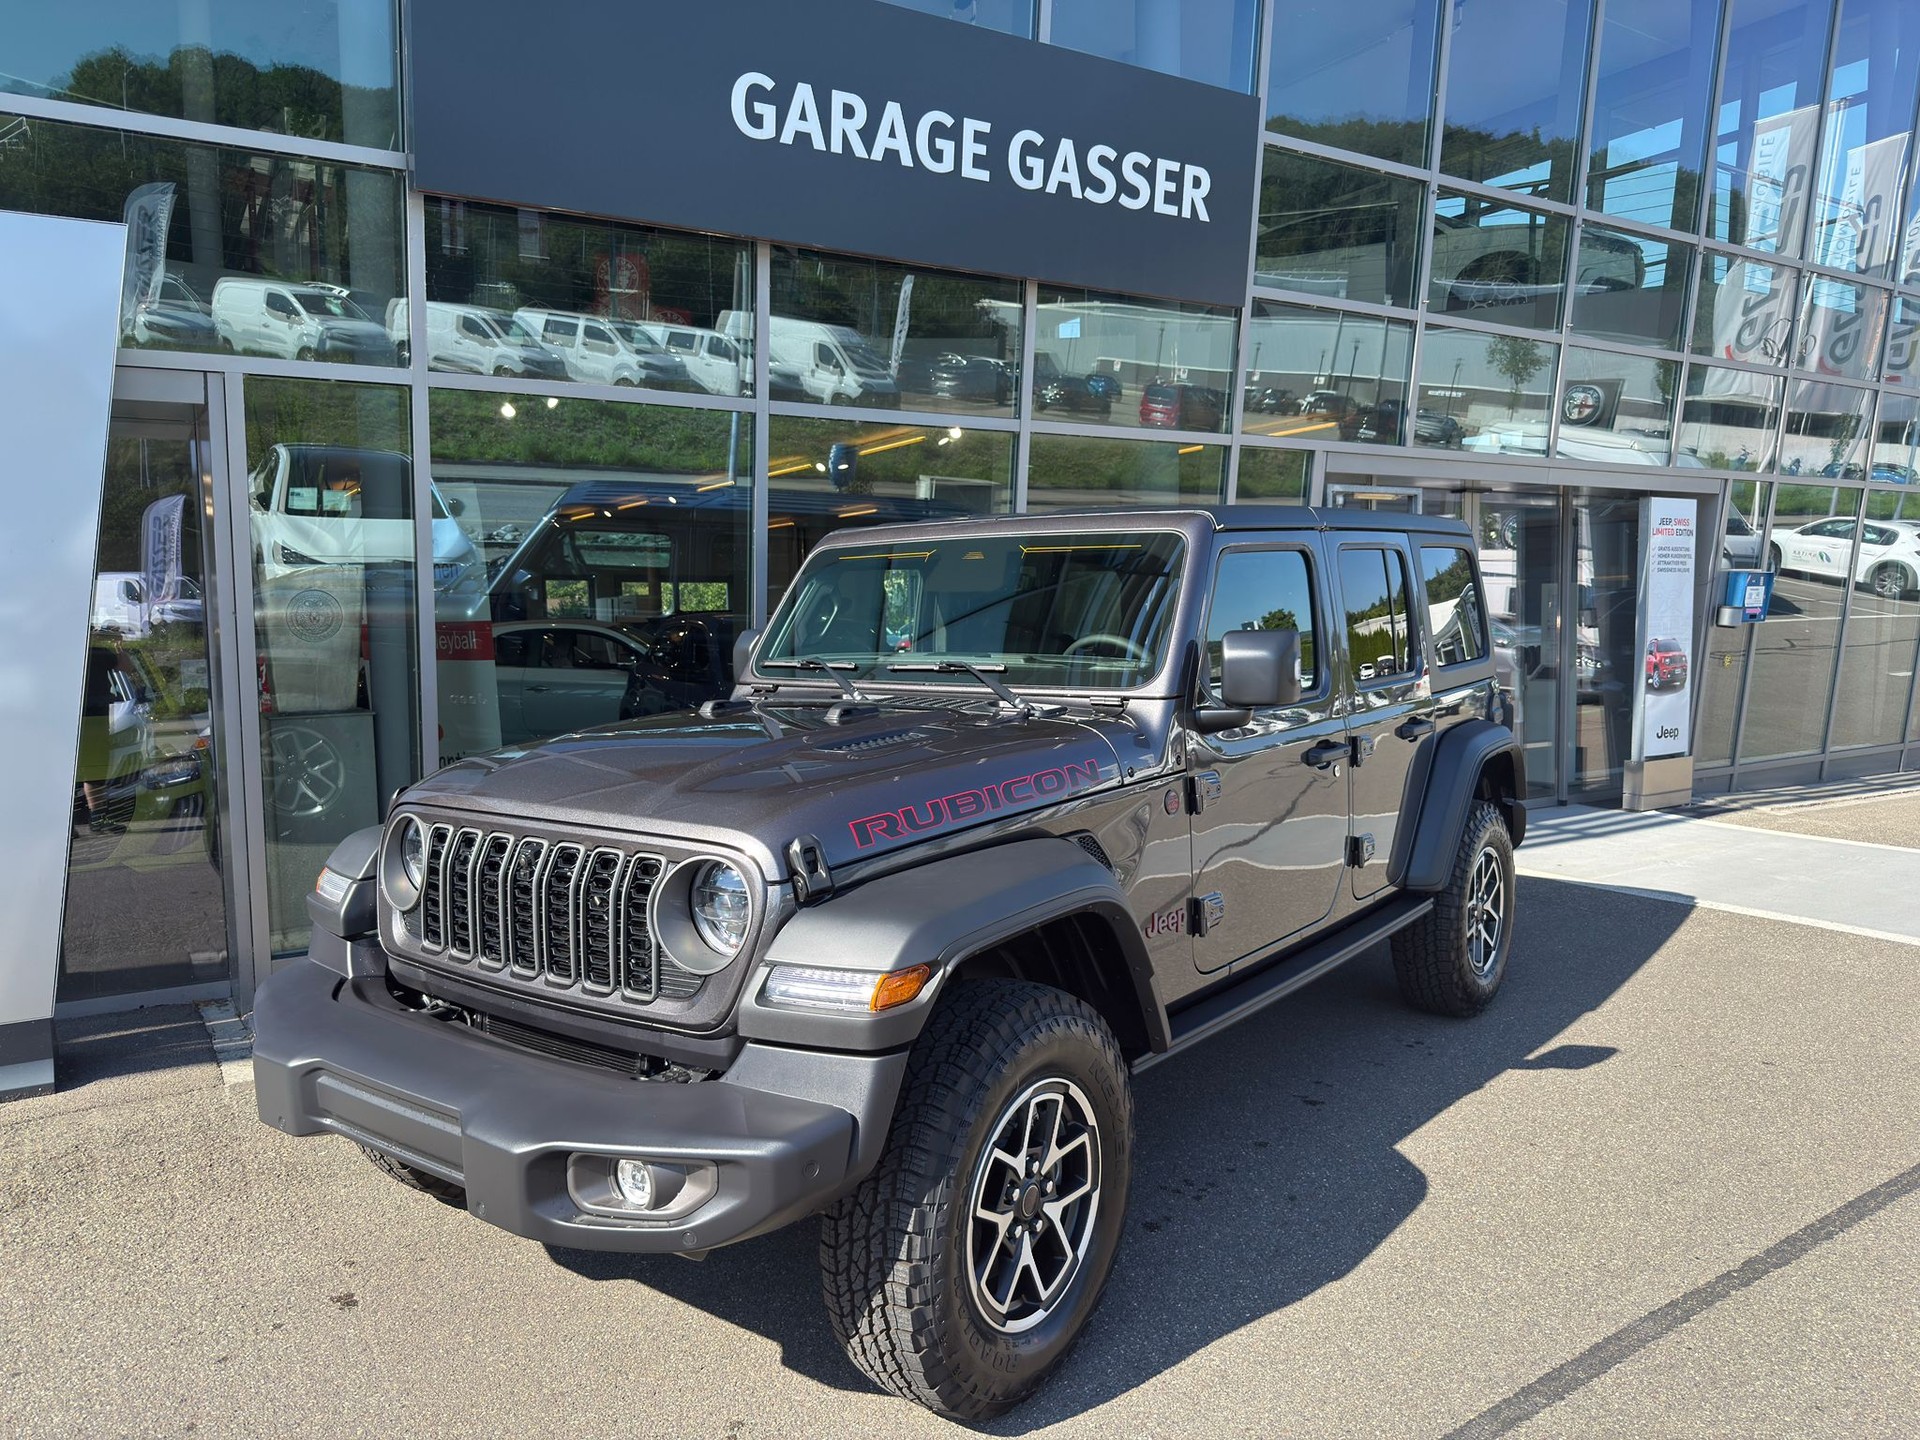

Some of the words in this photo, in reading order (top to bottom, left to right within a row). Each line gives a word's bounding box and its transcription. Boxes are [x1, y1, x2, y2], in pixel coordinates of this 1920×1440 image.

[730, 71, 991, 182] GARAGE
[1008, 129, 1211, 222] GASSER
[1652, 528, 1675, 536] LIMITED
[1674, 518, 1690, 526] SWISS
[436, 629, 477, 654] leyball
[1656, 725, 1679, 740] Jeep
[849, 759, 1102, 849] RUBICON
[1145, 907, 1184, 939] Jeep
